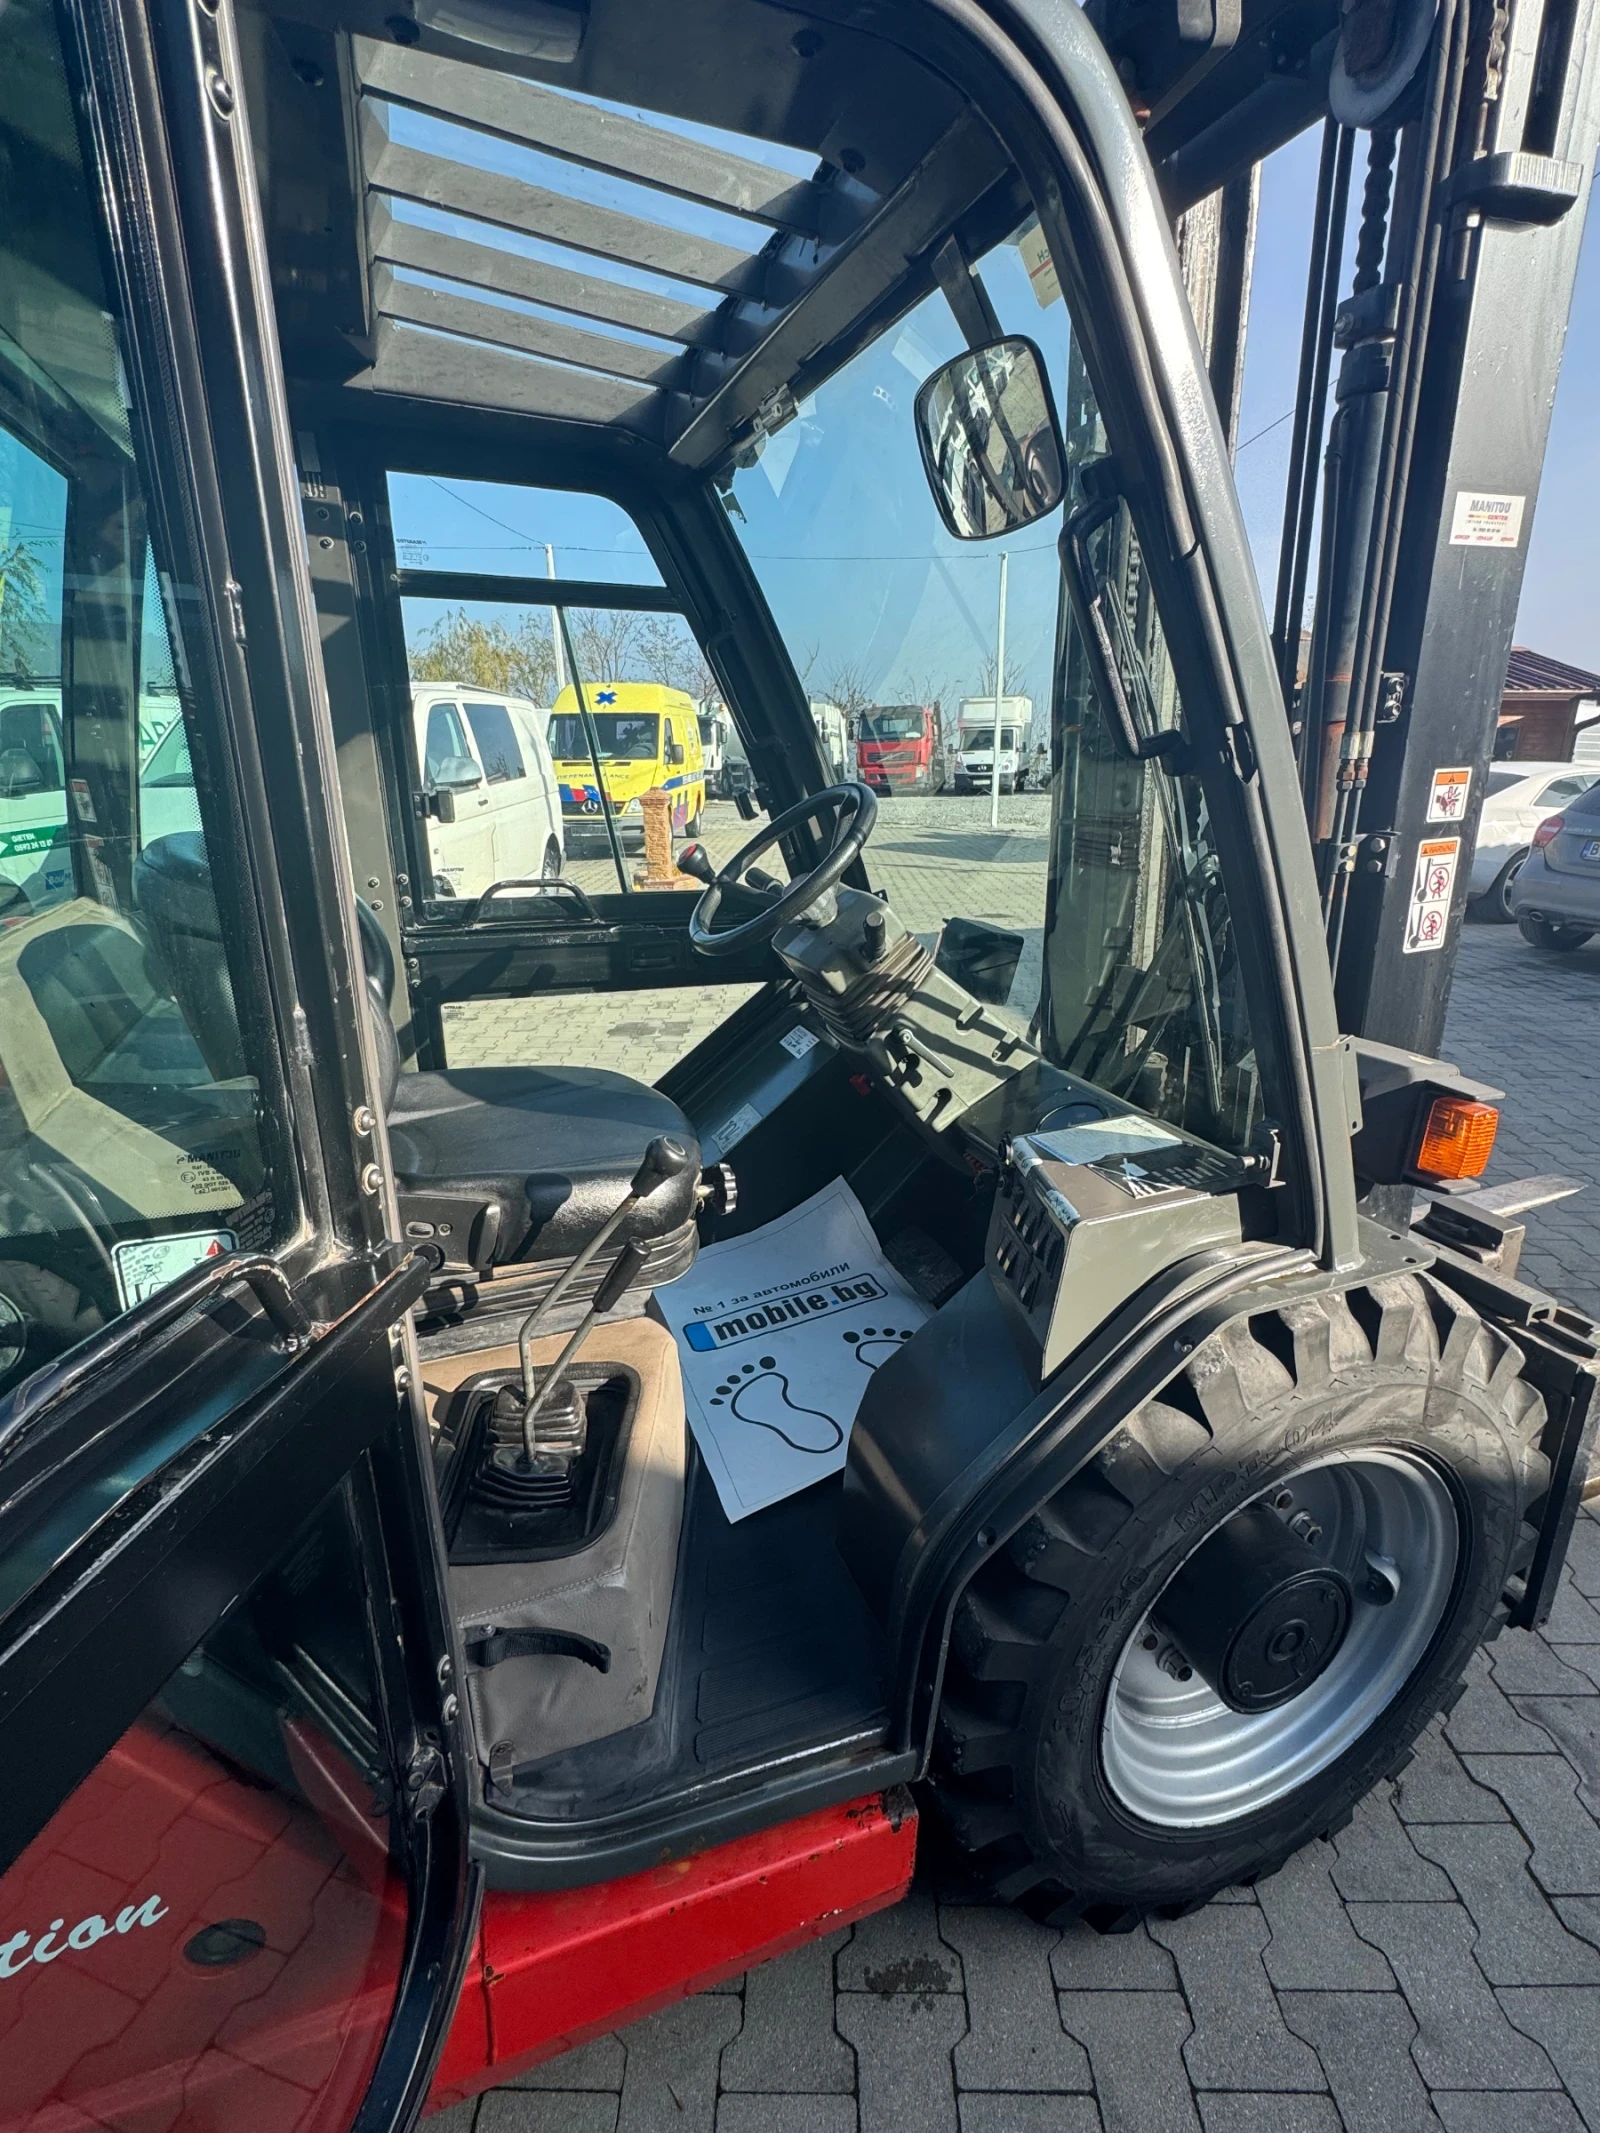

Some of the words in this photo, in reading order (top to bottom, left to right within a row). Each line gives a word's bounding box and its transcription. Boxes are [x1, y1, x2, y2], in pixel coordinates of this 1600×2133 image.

[1470, 500, 1512, 513] MANITOU
[187, 1149, 241, 1164] MANITOU
[718, 1300, 726, 1309] 1
[731, 1294, 749, 1305] за
[753, 1262, 851, 1299] автомобили
[713, 1279, 878, 1341] mobile.bg
